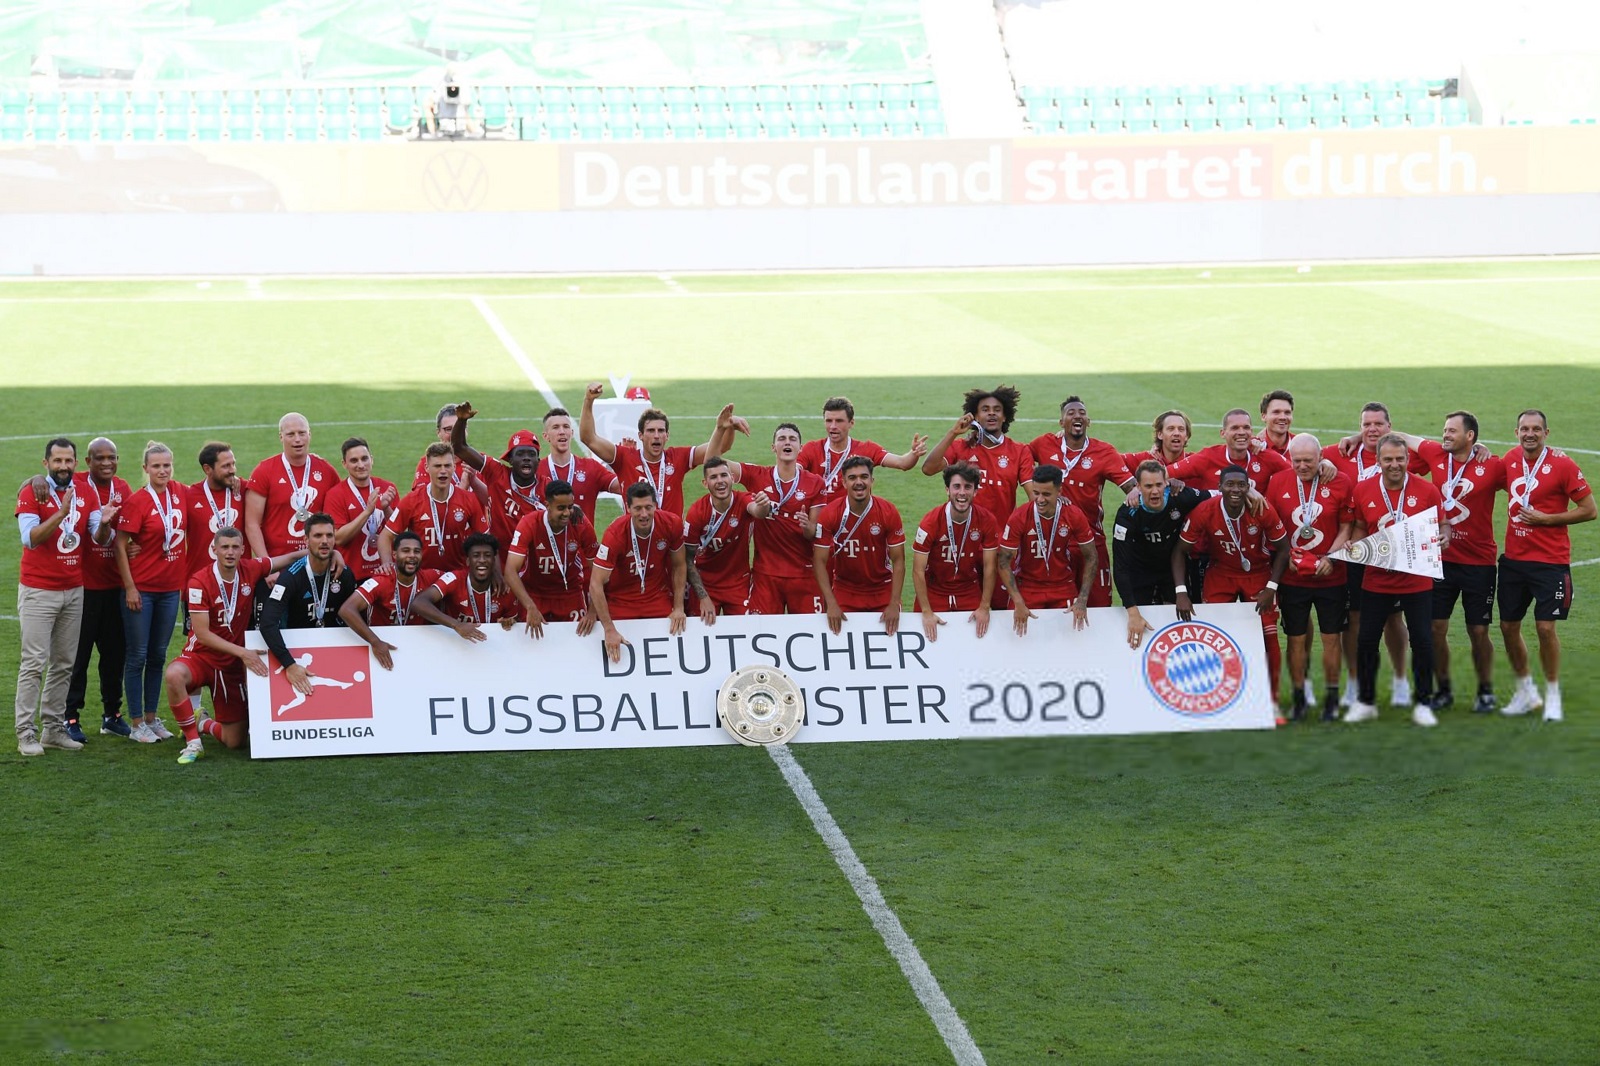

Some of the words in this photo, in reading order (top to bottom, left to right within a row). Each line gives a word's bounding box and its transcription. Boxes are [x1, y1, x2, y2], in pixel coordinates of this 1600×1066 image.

[573, 144, 1003, 207] Deutschland
[1023, 147, 1264, 203] startet
[1283, 135, 1498, 196] durch.
[1290, 501, 1325, 551] 8
[813, 596, 823, 614] 5
[602, 631, 931, 679] DEUTSCHER
[1167, 626, 1234, 661] BAYERN
[967, 680, 1106, 723] 2020
[271, 725, 376, 742] BUNDESLIGA
